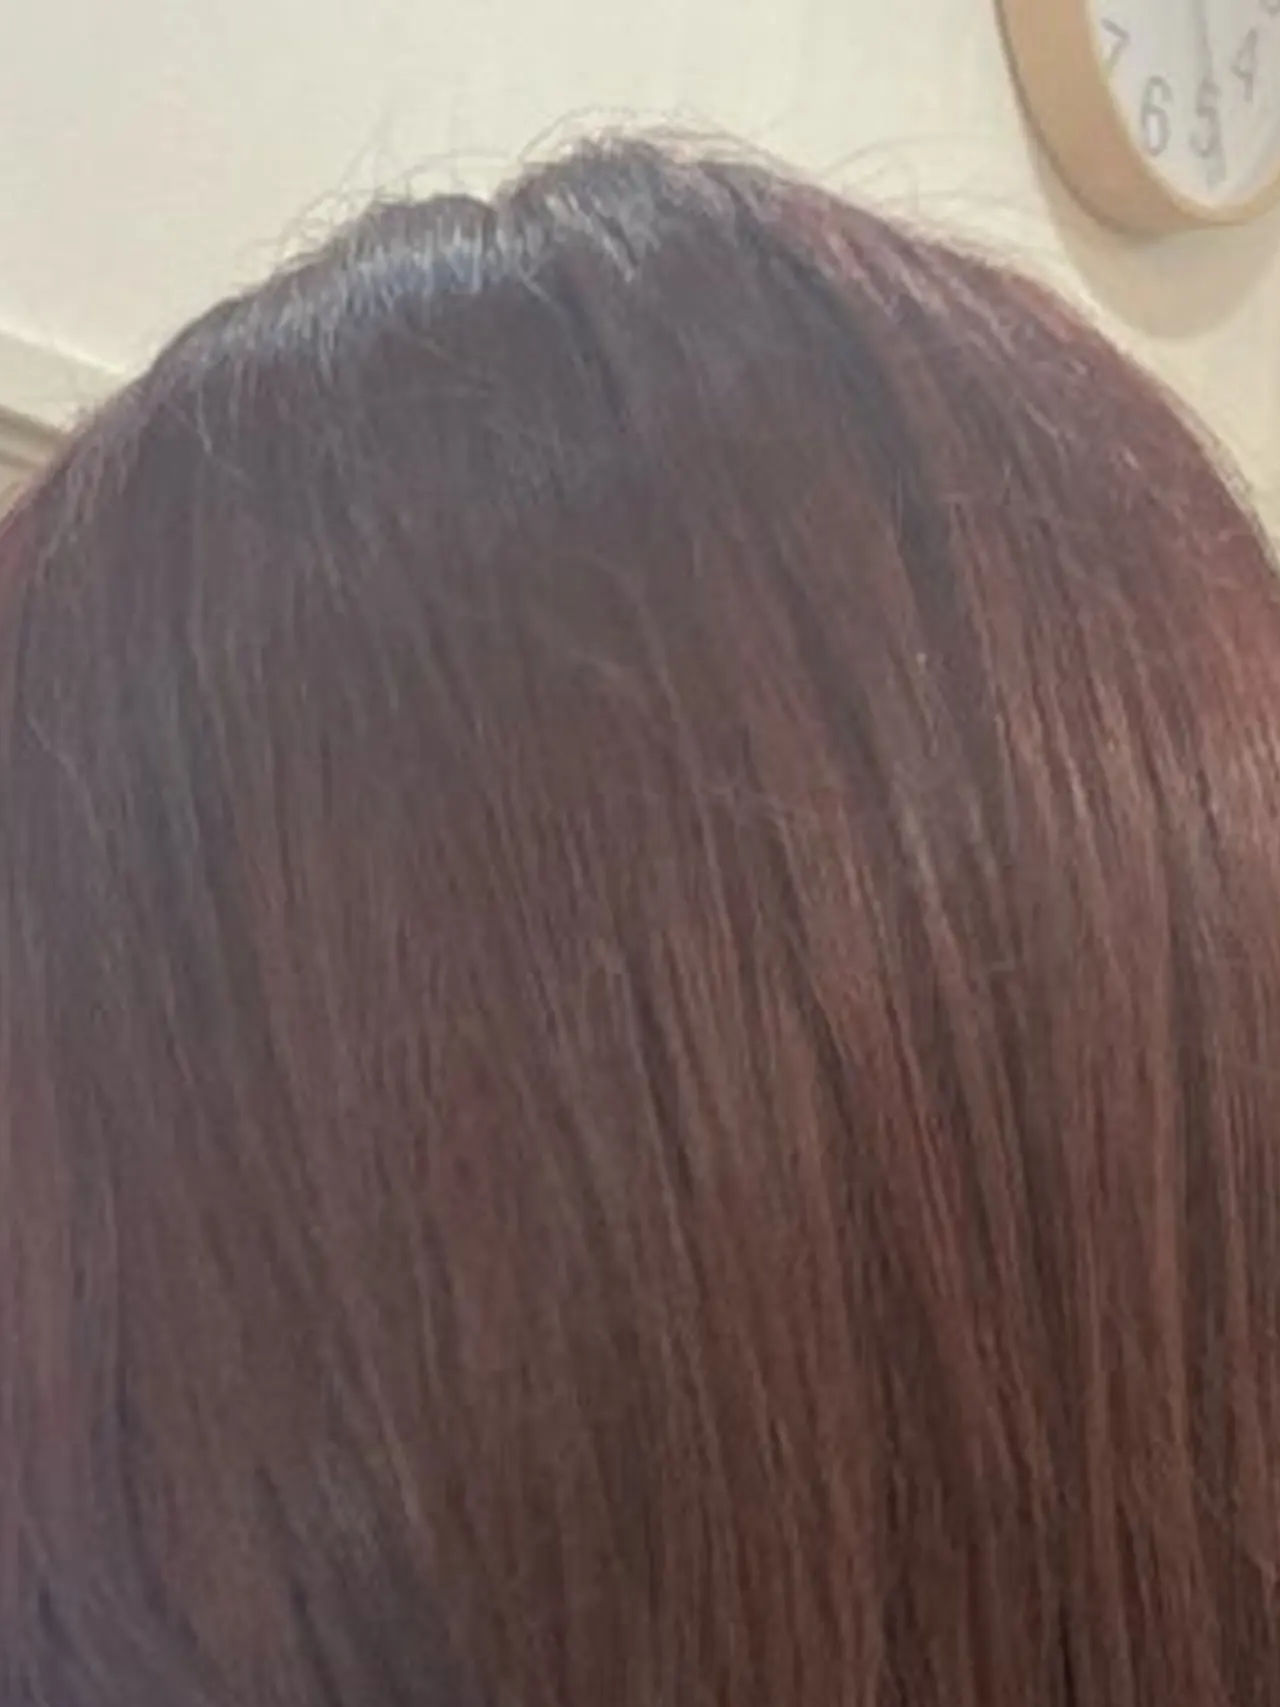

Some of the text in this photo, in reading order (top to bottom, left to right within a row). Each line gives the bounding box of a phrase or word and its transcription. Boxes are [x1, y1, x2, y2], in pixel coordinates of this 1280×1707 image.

[1230, 28, 1259, 103] 4
[1140, 75, 1174, 157] 6
[1189, 78, 1223, 160] 5
